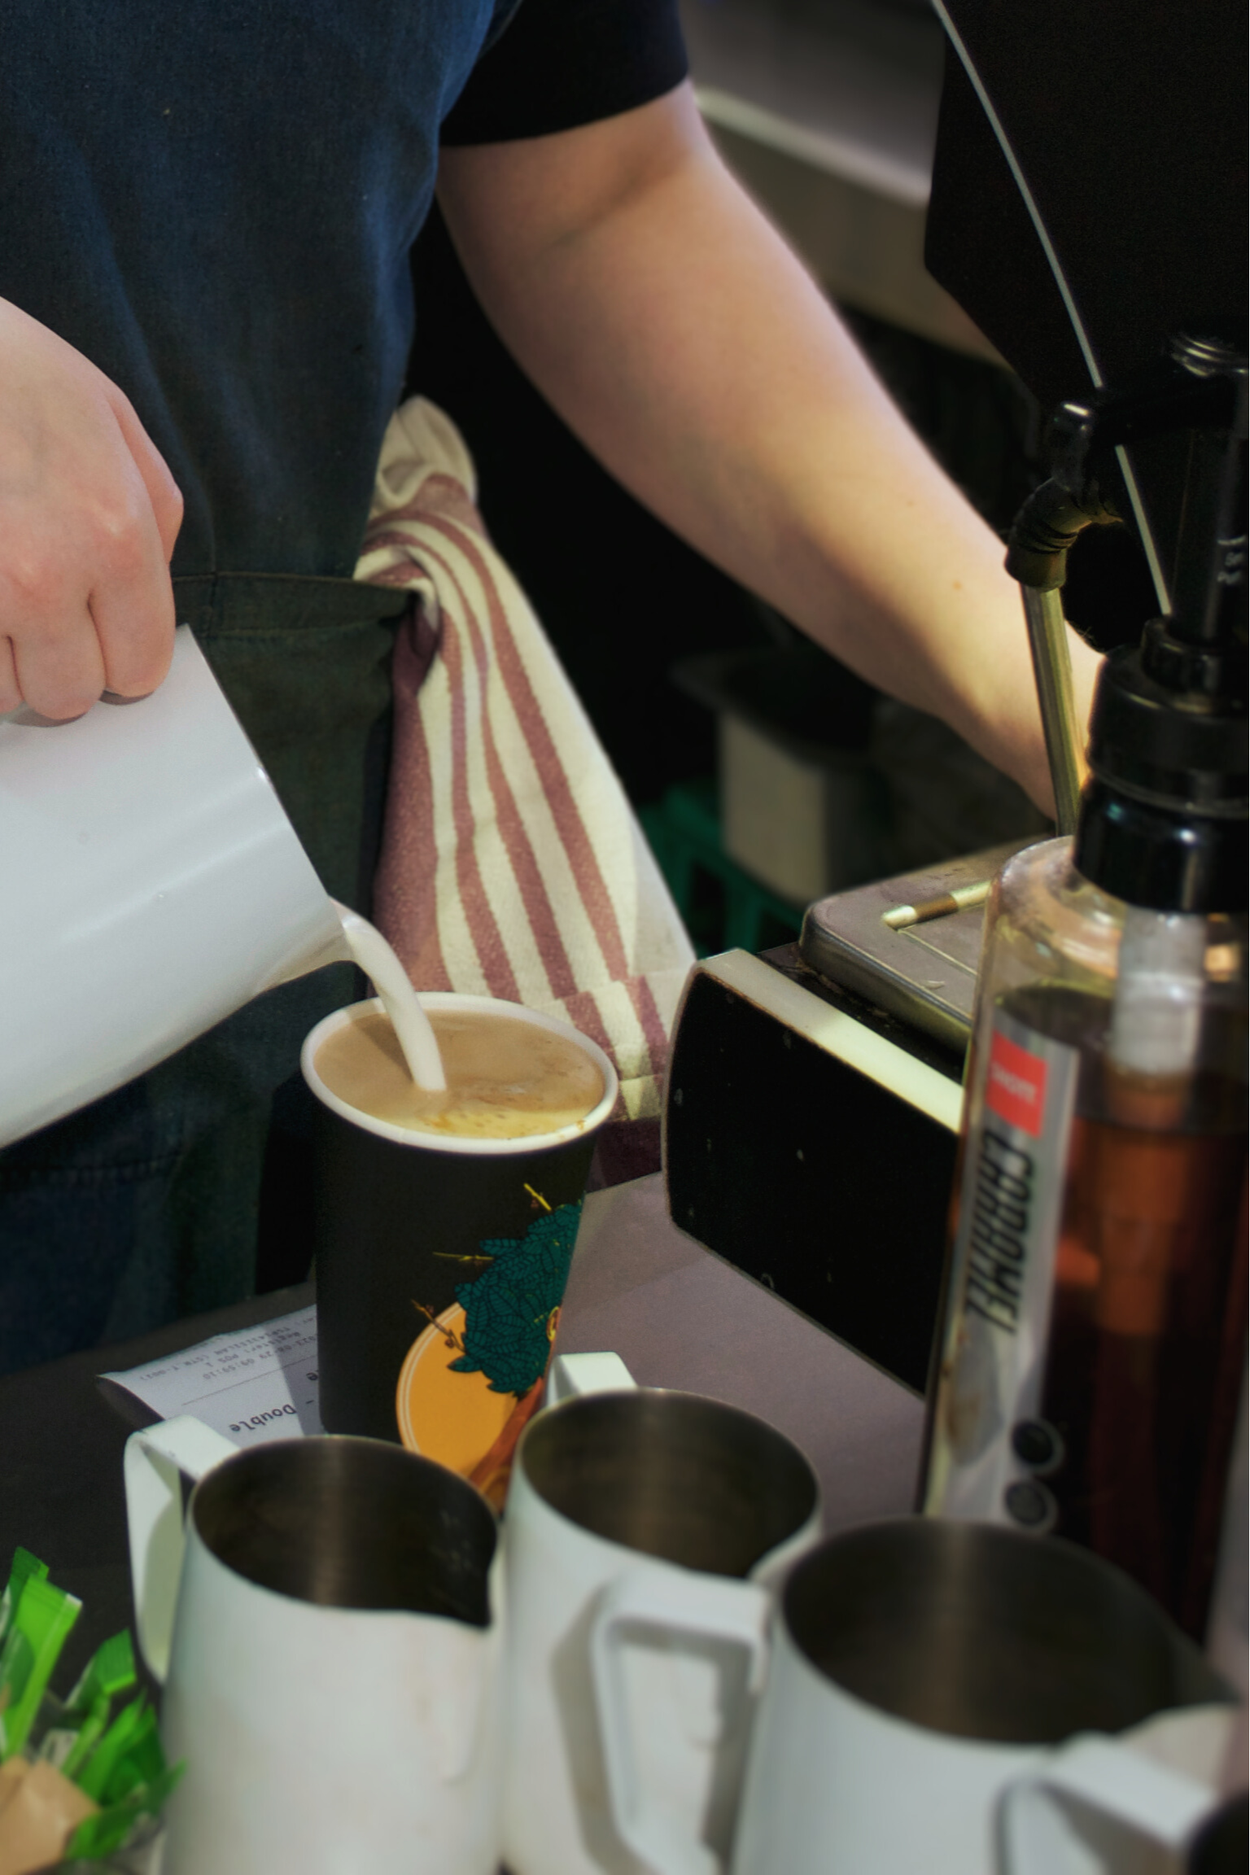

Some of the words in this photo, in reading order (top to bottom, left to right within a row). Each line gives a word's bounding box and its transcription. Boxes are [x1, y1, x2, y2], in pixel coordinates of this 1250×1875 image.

[967, 1128, 1034, 1338] CARAMEL
[259, 1334, 318, 1360] 023-08-29
[229, 1403, 297, 1432] Double
